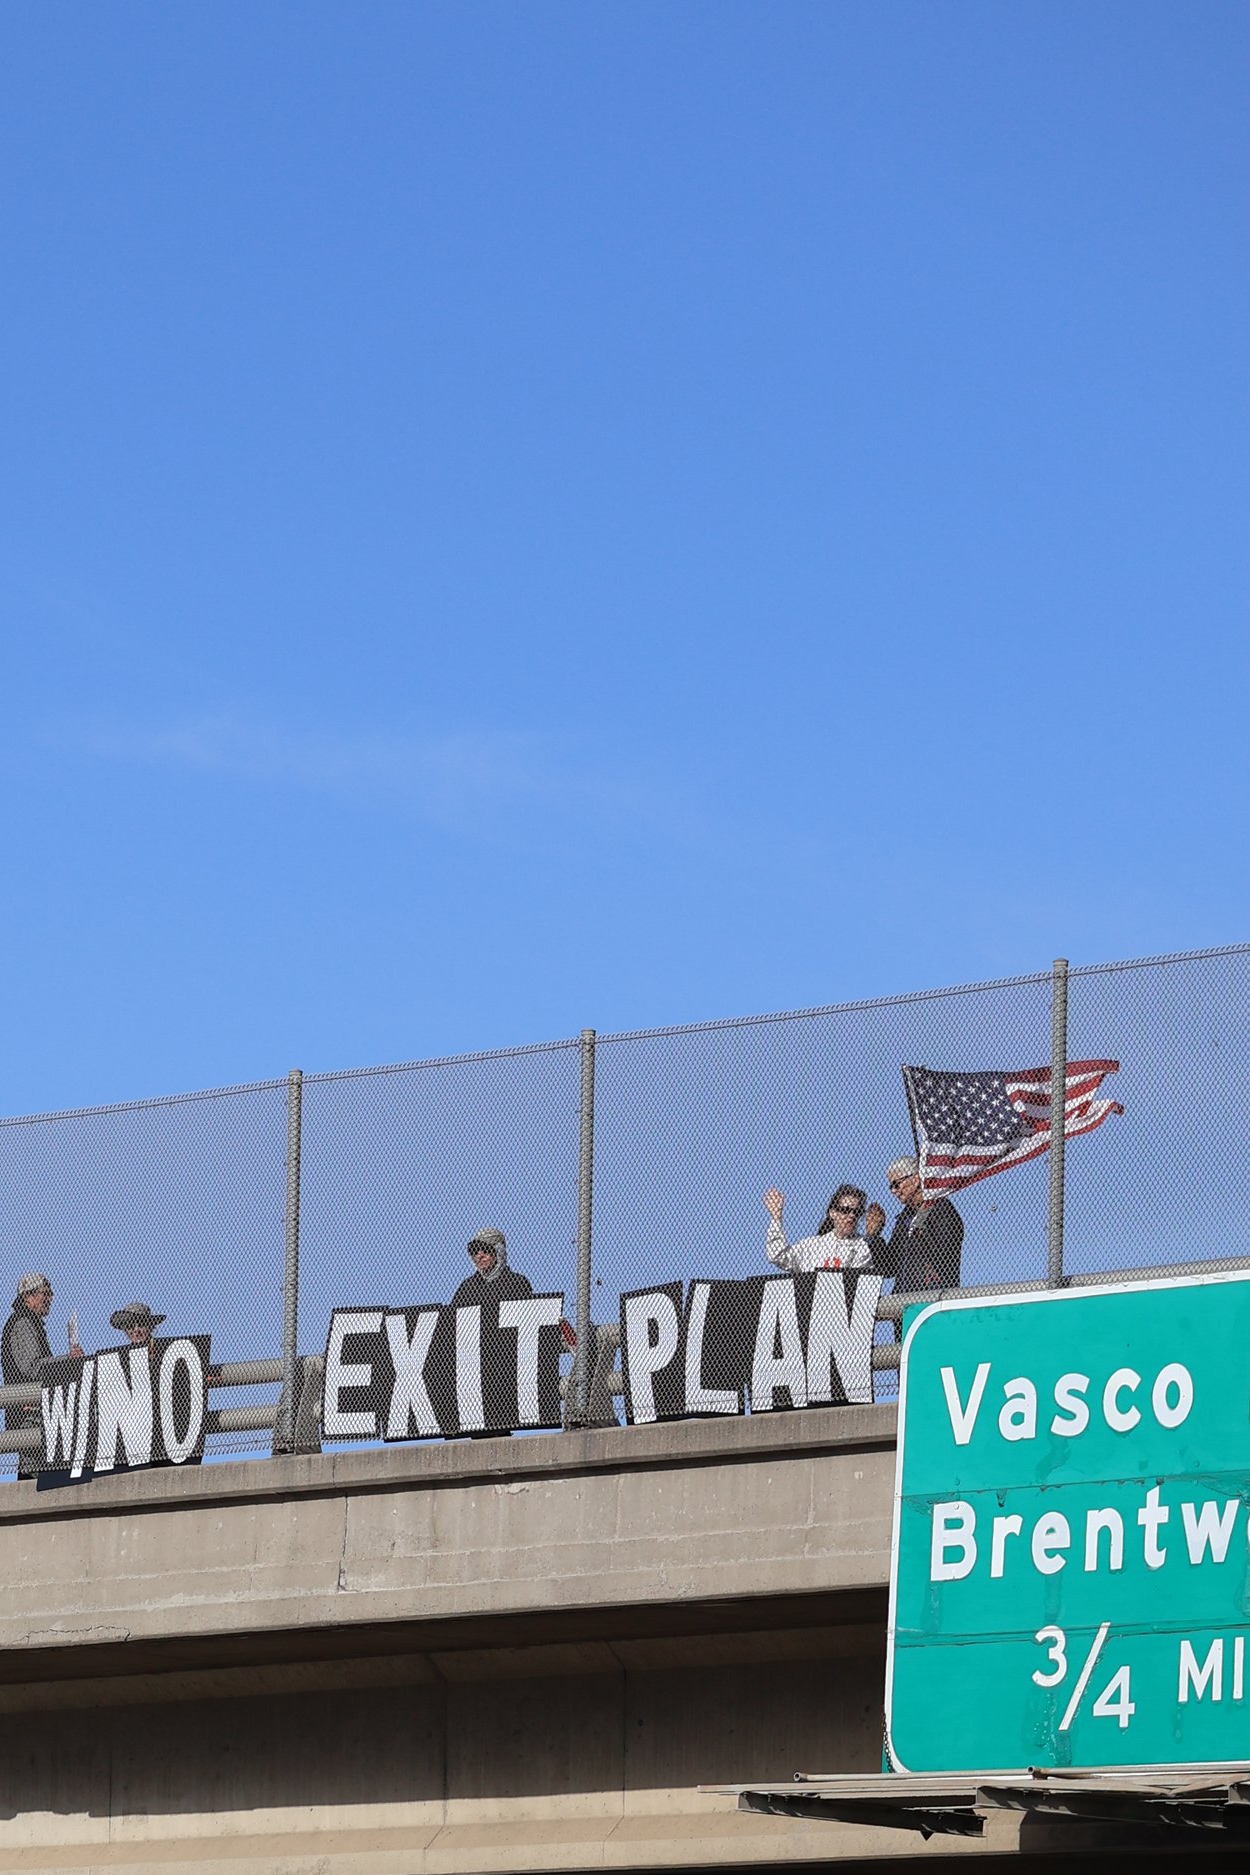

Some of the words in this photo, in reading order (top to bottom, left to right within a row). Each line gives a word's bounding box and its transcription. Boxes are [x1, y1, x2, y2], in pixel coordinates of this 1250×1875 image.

[323, 1297, 564, 1440] EXIT
[621, 1271, 883, 1424] PLAN
[940, 1362, 1194, 1446] Vasco
[930, 1485, 1250, 1582] Brentw
[1031, 1621, 1136, 1731] 3/4
